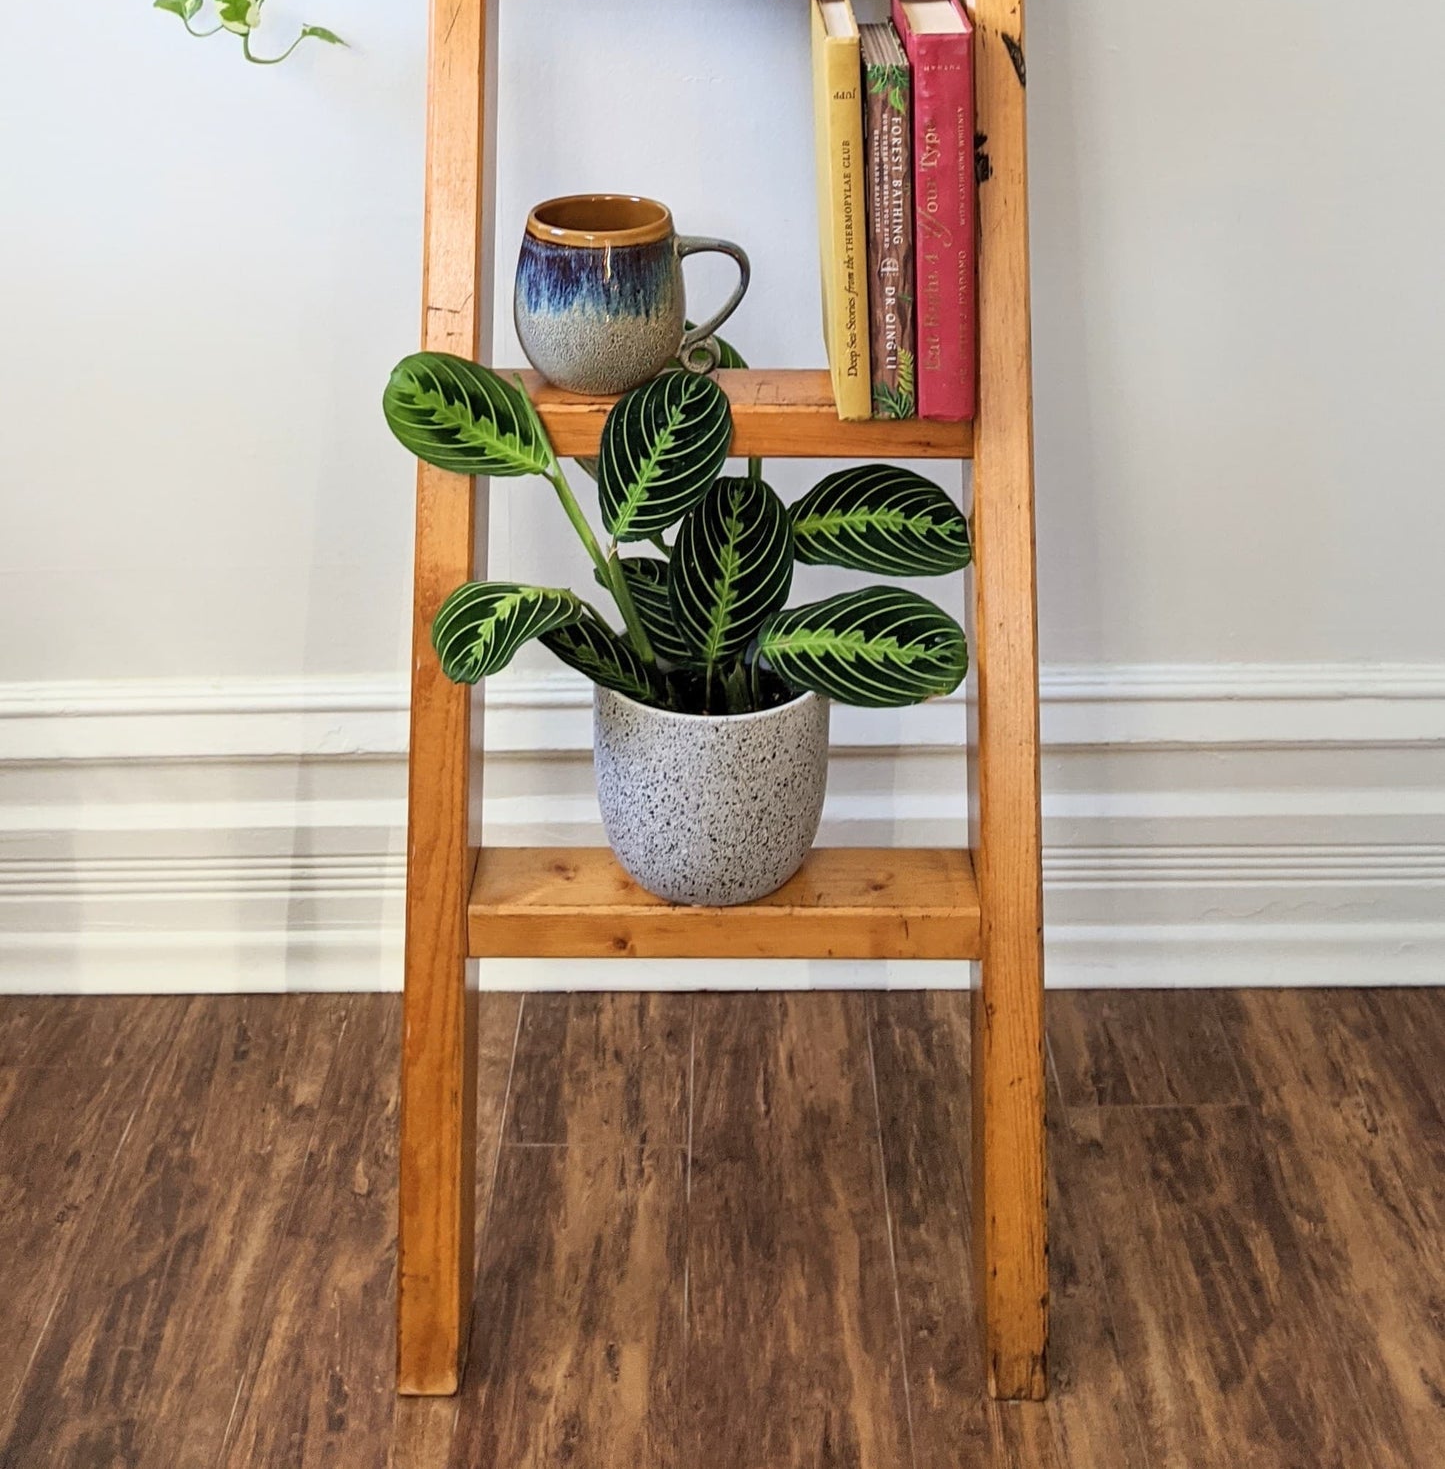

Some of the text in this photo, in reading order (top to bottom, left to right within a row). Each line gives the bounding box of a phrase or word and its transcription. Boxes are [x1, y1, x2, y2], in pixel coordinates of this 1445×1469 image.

[833, 88, 856, 100] JUPP
[891, 117, 903, 245] FOREST BATHING
[842, 140, 860, 377] Deep Sea Stories from the THERMOPYLAE CLUB
[885, 286, 895, 309] DR.
[885, 313, 896, 350] QING
[886, 356, 897, 369] LI
